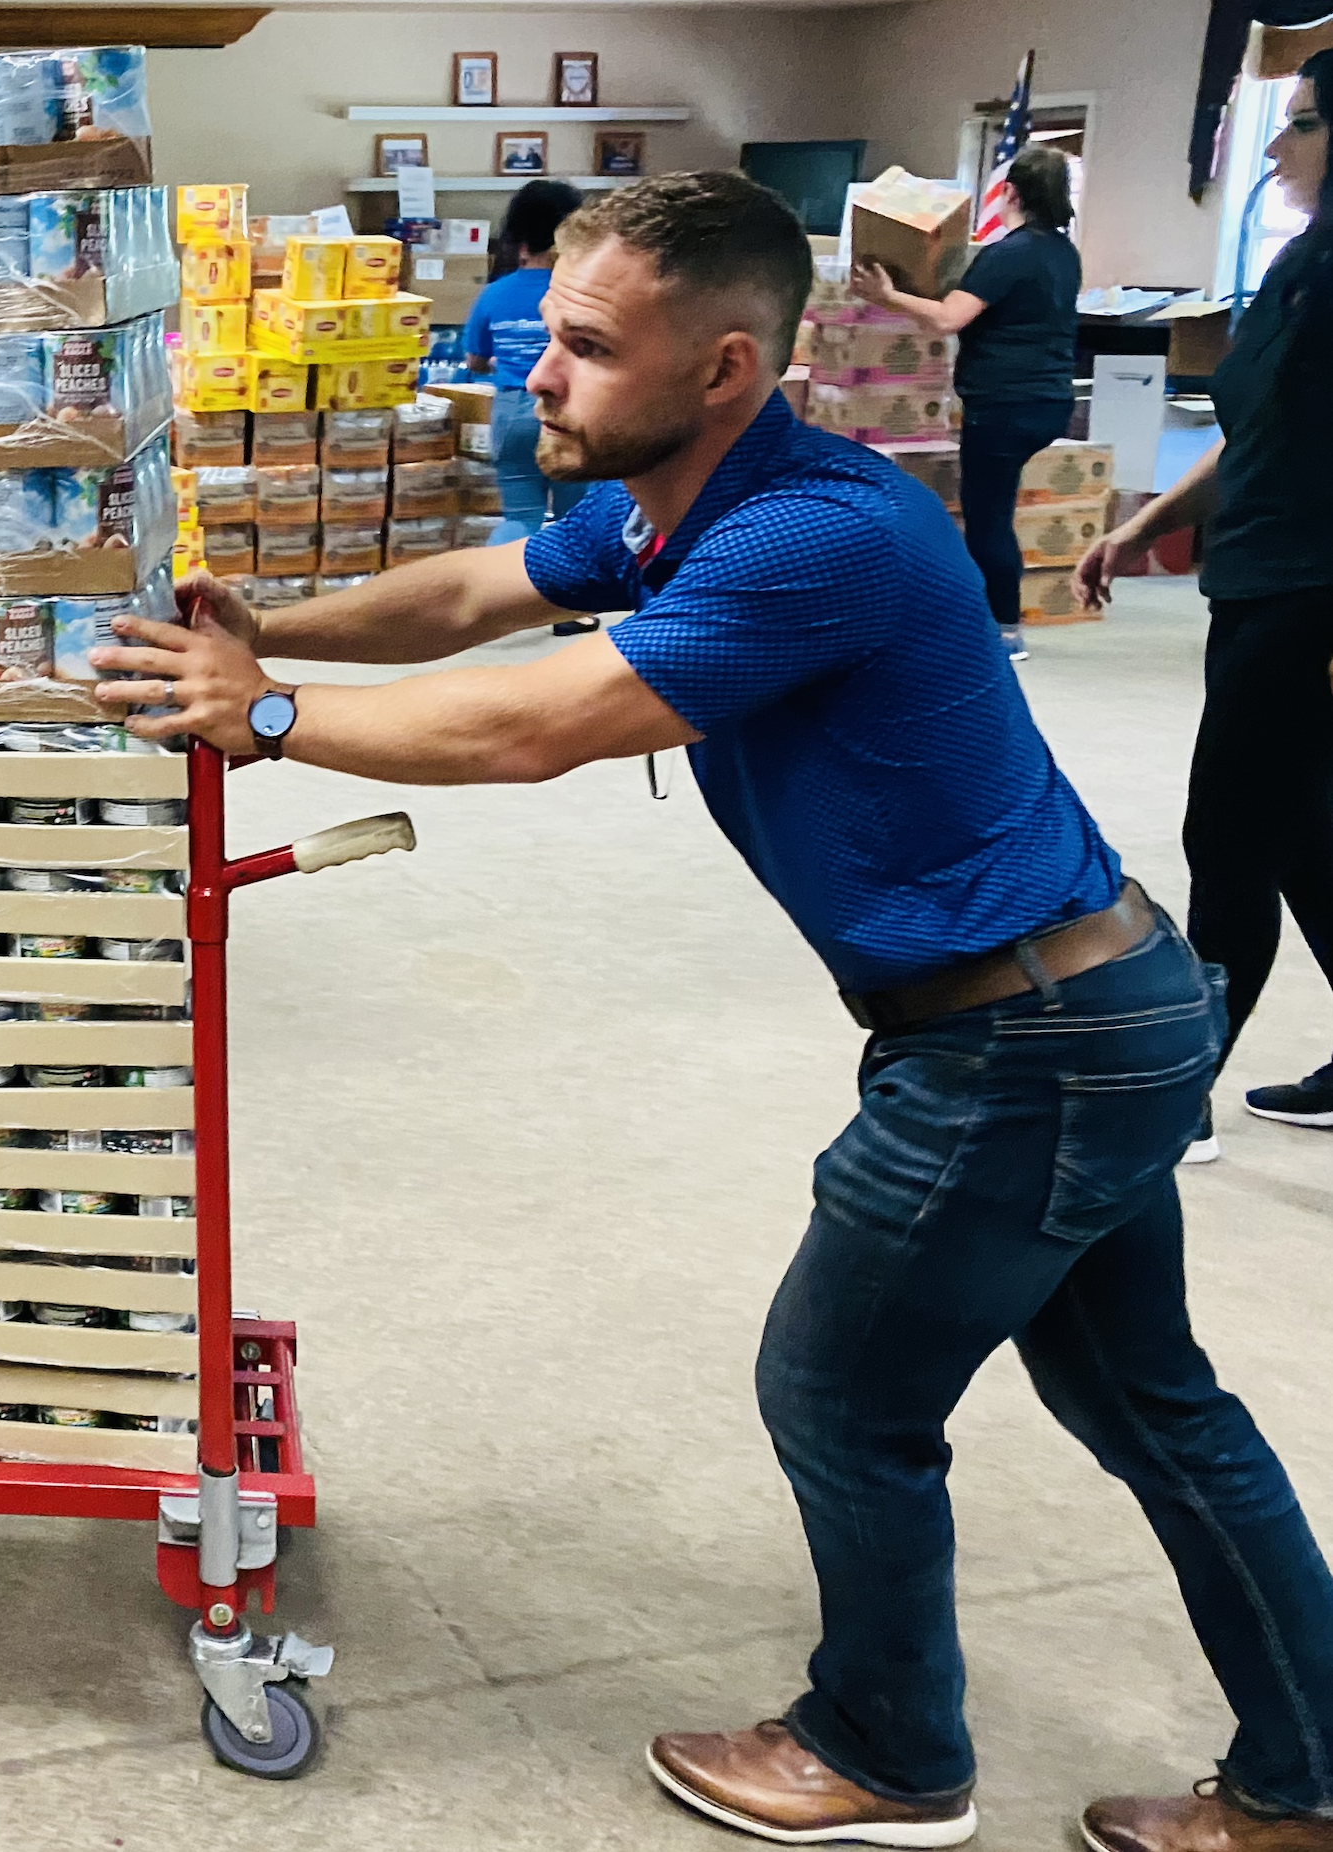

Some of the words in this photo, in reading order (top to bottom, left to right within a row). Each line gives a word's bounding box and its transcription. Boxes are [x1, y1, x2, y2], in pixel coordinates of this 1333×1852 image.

[59, 363, 101, 377] SLICED
[54, 377, 107, 393] PEACHES
[108, 491, 135, 506] SLIC
[4, 626, 43, 641] SLICED
